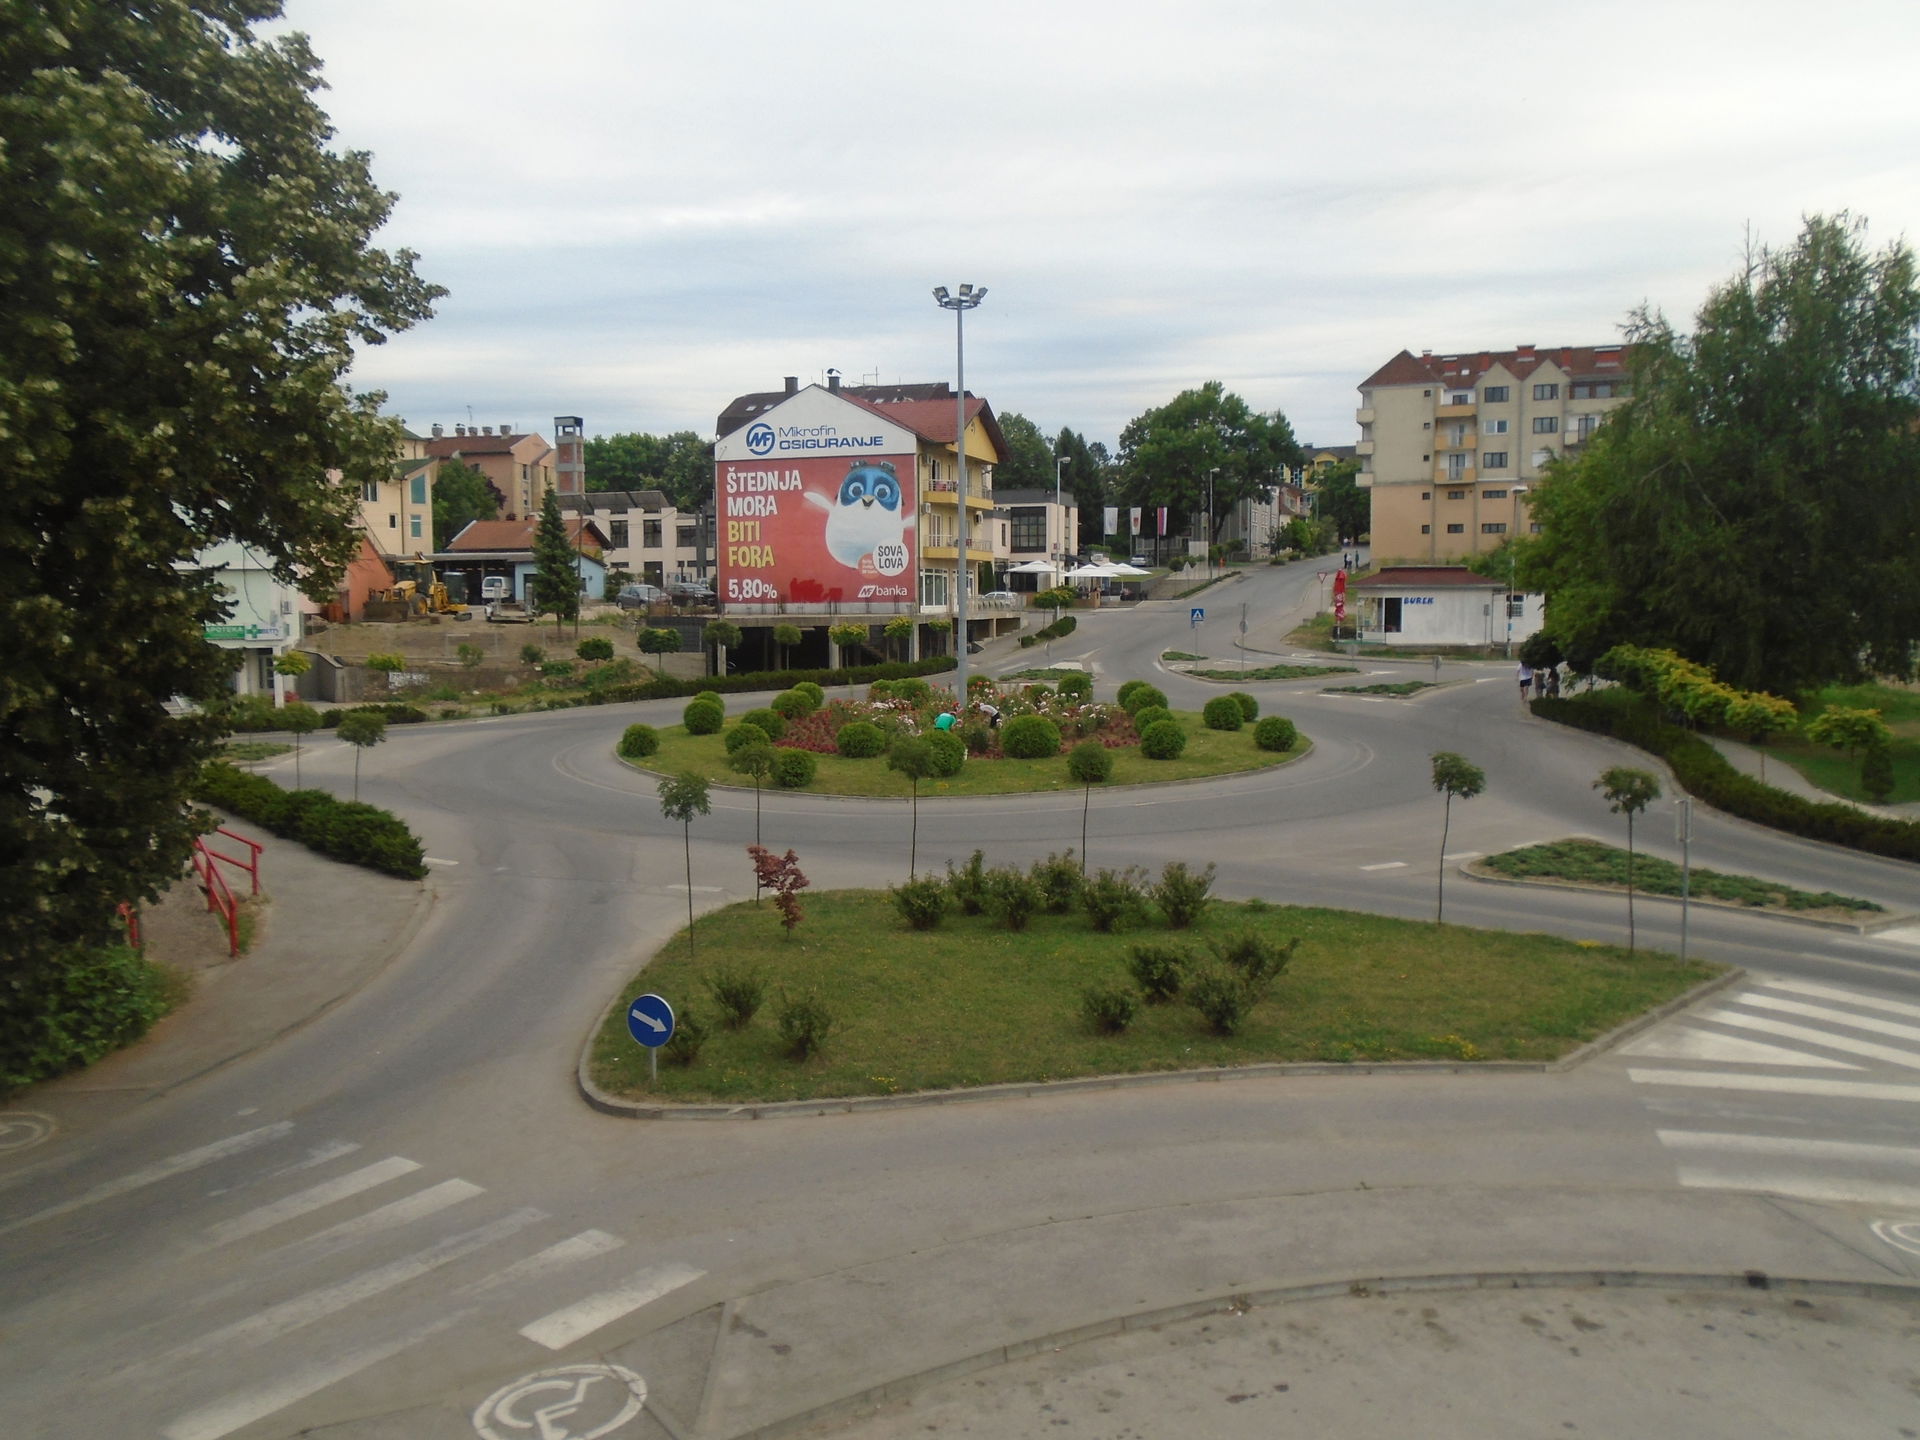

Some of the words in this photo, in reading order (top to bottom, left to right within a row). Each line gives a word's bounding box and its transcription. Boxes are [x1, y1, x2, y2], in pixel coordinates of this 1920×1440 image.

[779, 425, 836, 437] Mikrofin
[779, 436, 883, 450] OSIGURANJE
[726, 466, 803, 493] ŠTEDNJA
[727, 495, 778, 517] MORA
[727, 520, 760, 543] BITI
[728, 545, 776, 568] FORA
[878, 545, 903, 557] SOVA
[878, 557, 904, 569] LOVA
[728, 578, 778, 601] 5,80%
[876, 585, 908, 596] banka
[1403, 597, 1434, 605] BUREK
